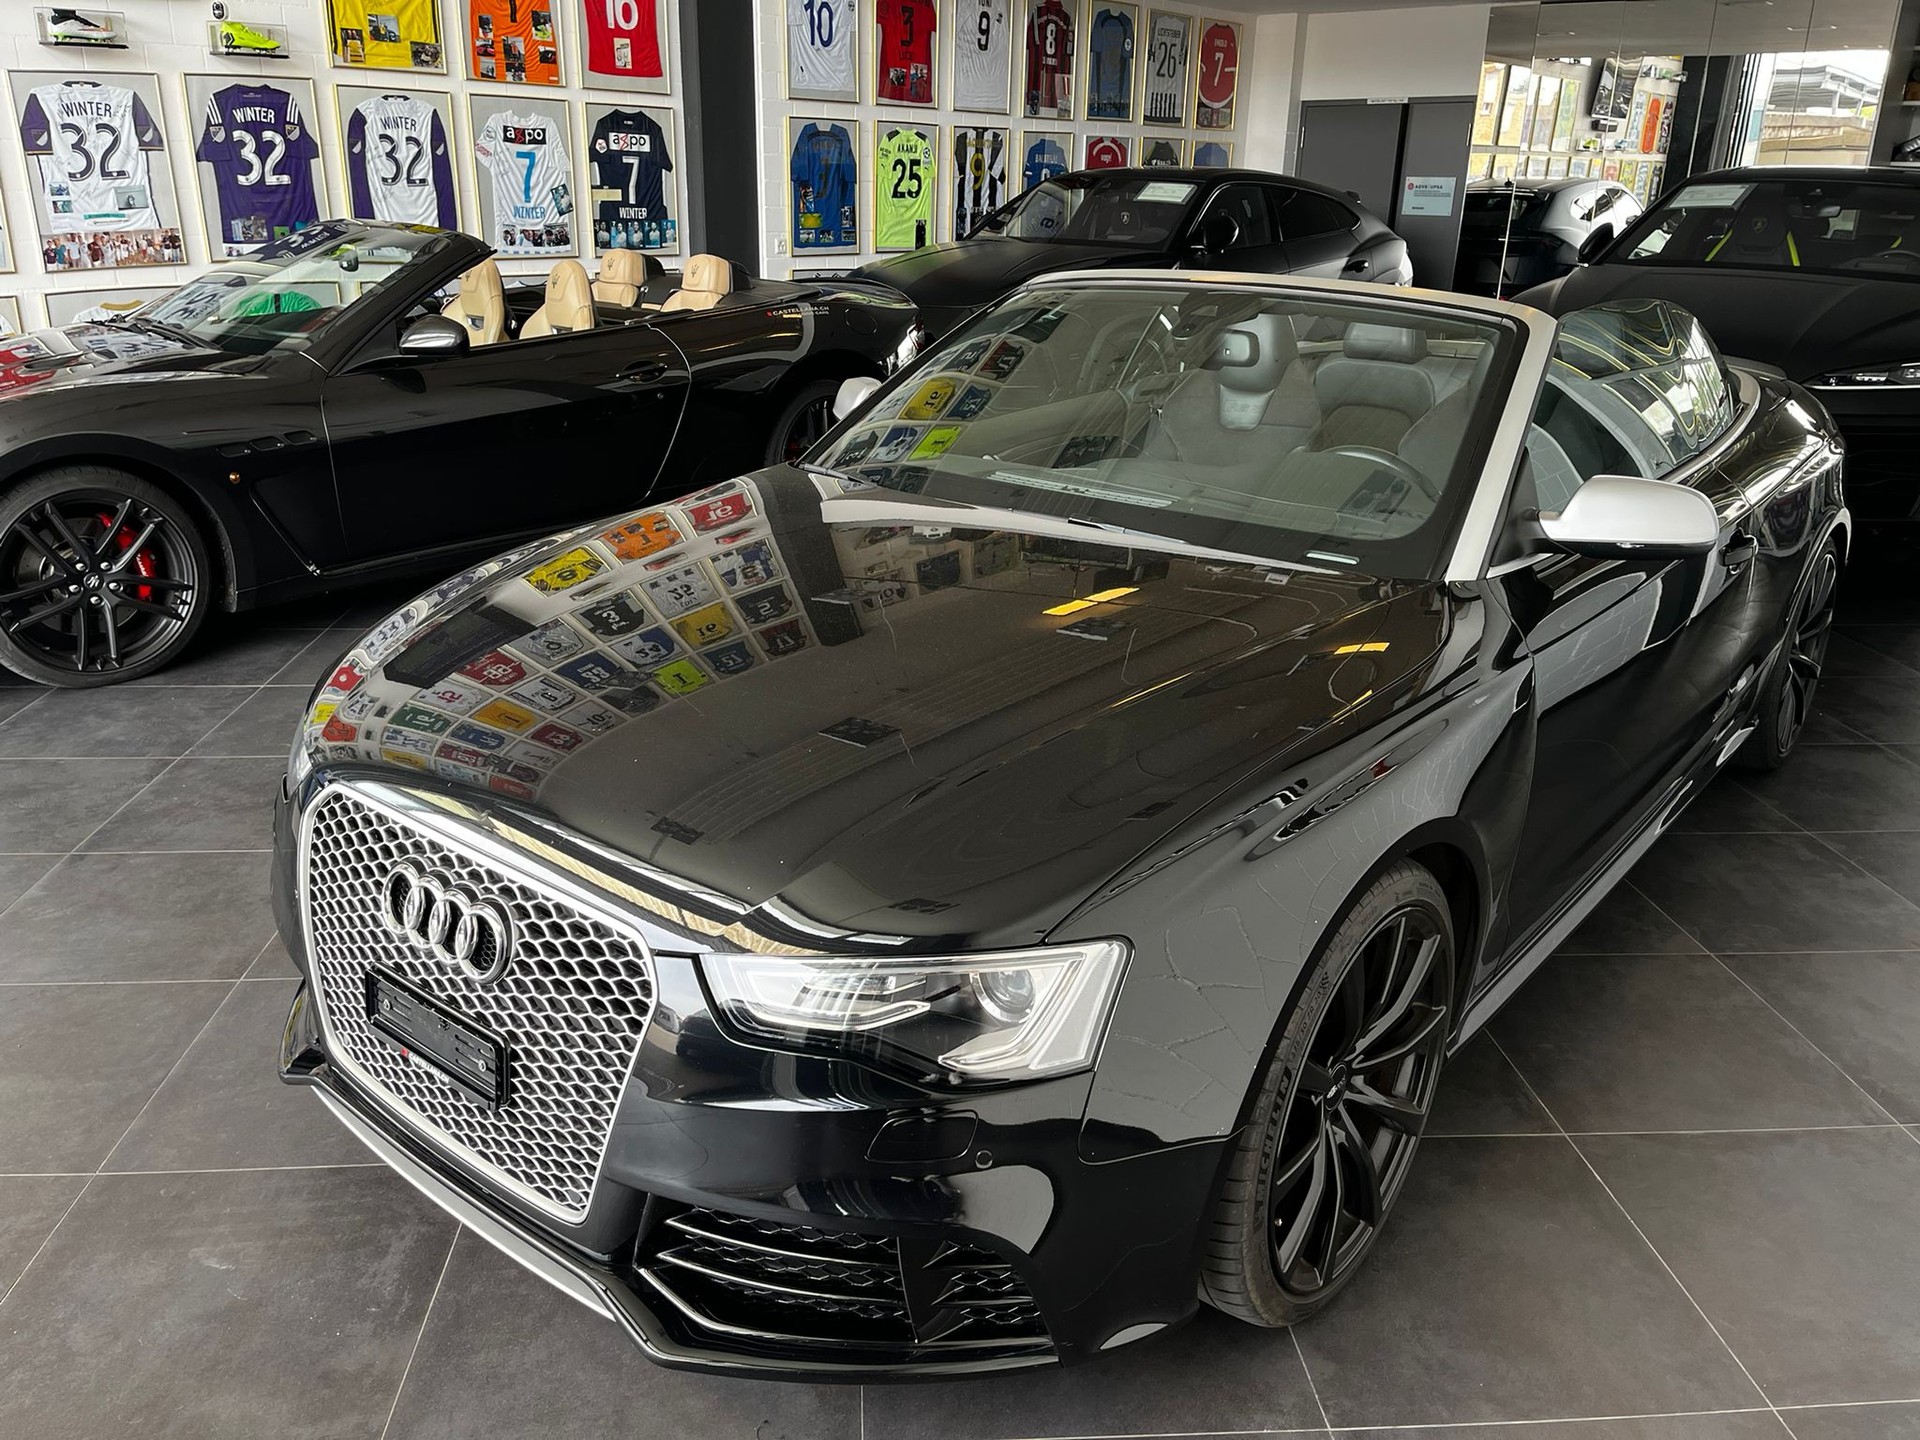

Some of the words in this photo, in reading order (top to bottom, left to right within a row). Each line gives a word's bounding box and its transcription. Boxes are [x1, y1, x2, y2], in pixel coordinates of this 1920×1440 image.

[803, 0, 834, 47] 10
[900, 6, 914, 47] 3
[977, 10, 991, 52] 9
[1045, 23, 1057, 55] 8
[1156, 42, 1177, 79] 26
[1214, 52, 1225, 87] 7
[60, 101, 113, 119] WINTER
[231, 106, 276, 124] WINTER
[380, 116, 417, 132] WINTER
[60, 122, 131, 182] 32
[231, 129, 292, 186] 32
[378, 133, 429, 188] 32
[970, 152, 986, 191] 9
[515, 151, 537, 204] 7
[622, 155, 640, 205] 7
[891, 157, 923, 199] 25
[512, 204, 546, 220] WINTER
[618, 207, 648, 220] WINTER
[1255, 1066, 1293, 1200] MICHELIN
